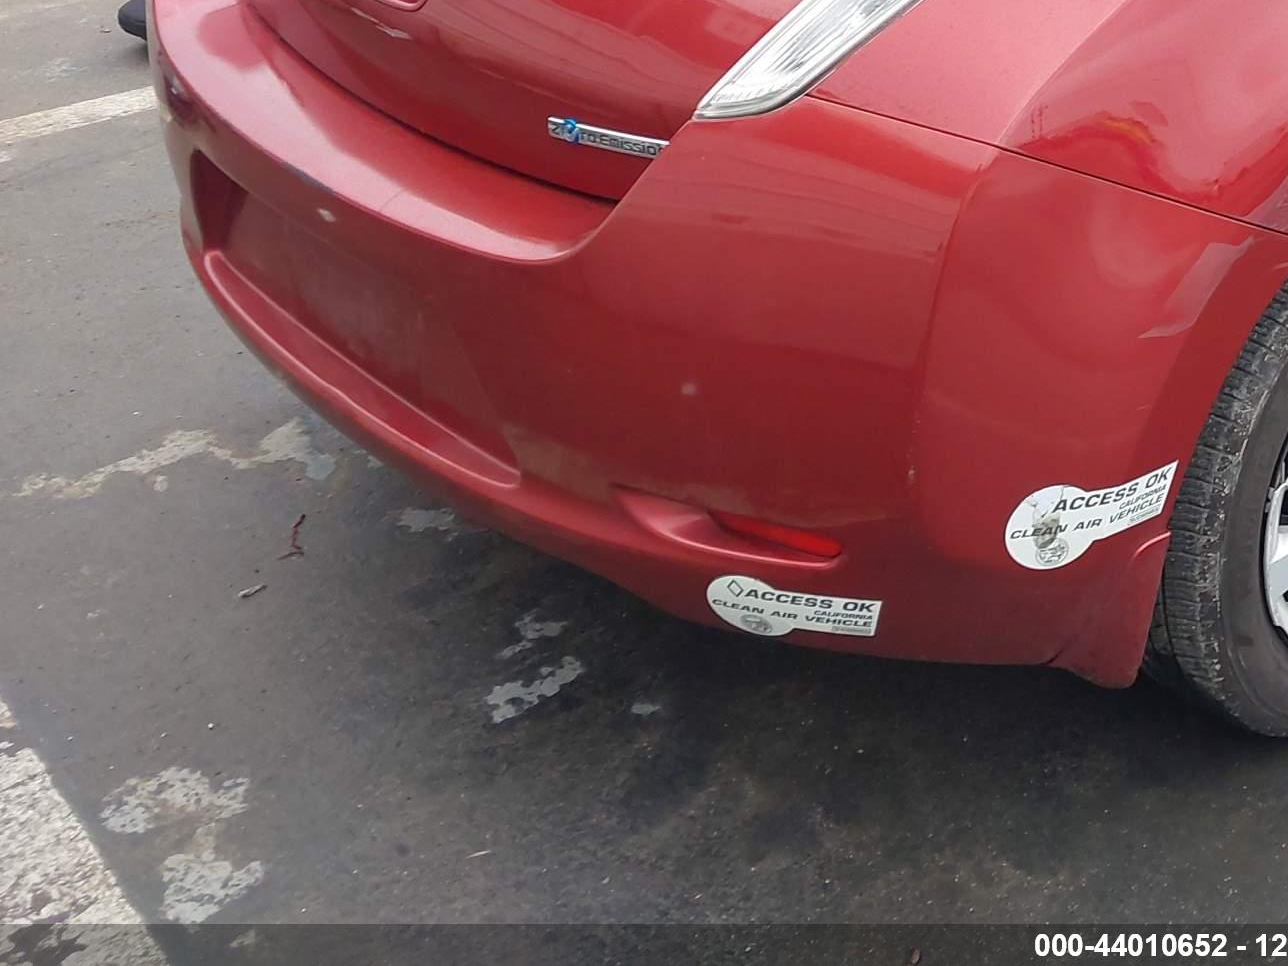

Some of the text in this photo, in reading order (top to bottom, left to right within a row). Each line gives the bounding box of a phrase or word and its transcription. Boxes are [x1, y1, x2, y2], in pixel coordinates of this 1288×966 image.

[1052, 466, 1174, 514] ACCESS OK
[1119, 484, 1167, 510] CALIFORNIA
[1009, 524, 1069, 541] CLEAN
[1073, 518, 1104, 531] AIR
[1109, 492, 1165, 525] VEHICLE
[711, 598, 873, 628] CLEAN AIR VEHICLE
[744, 589, 878, 613] ACCESS OK
[813, 610, 874, 621] CALIFORNIA
